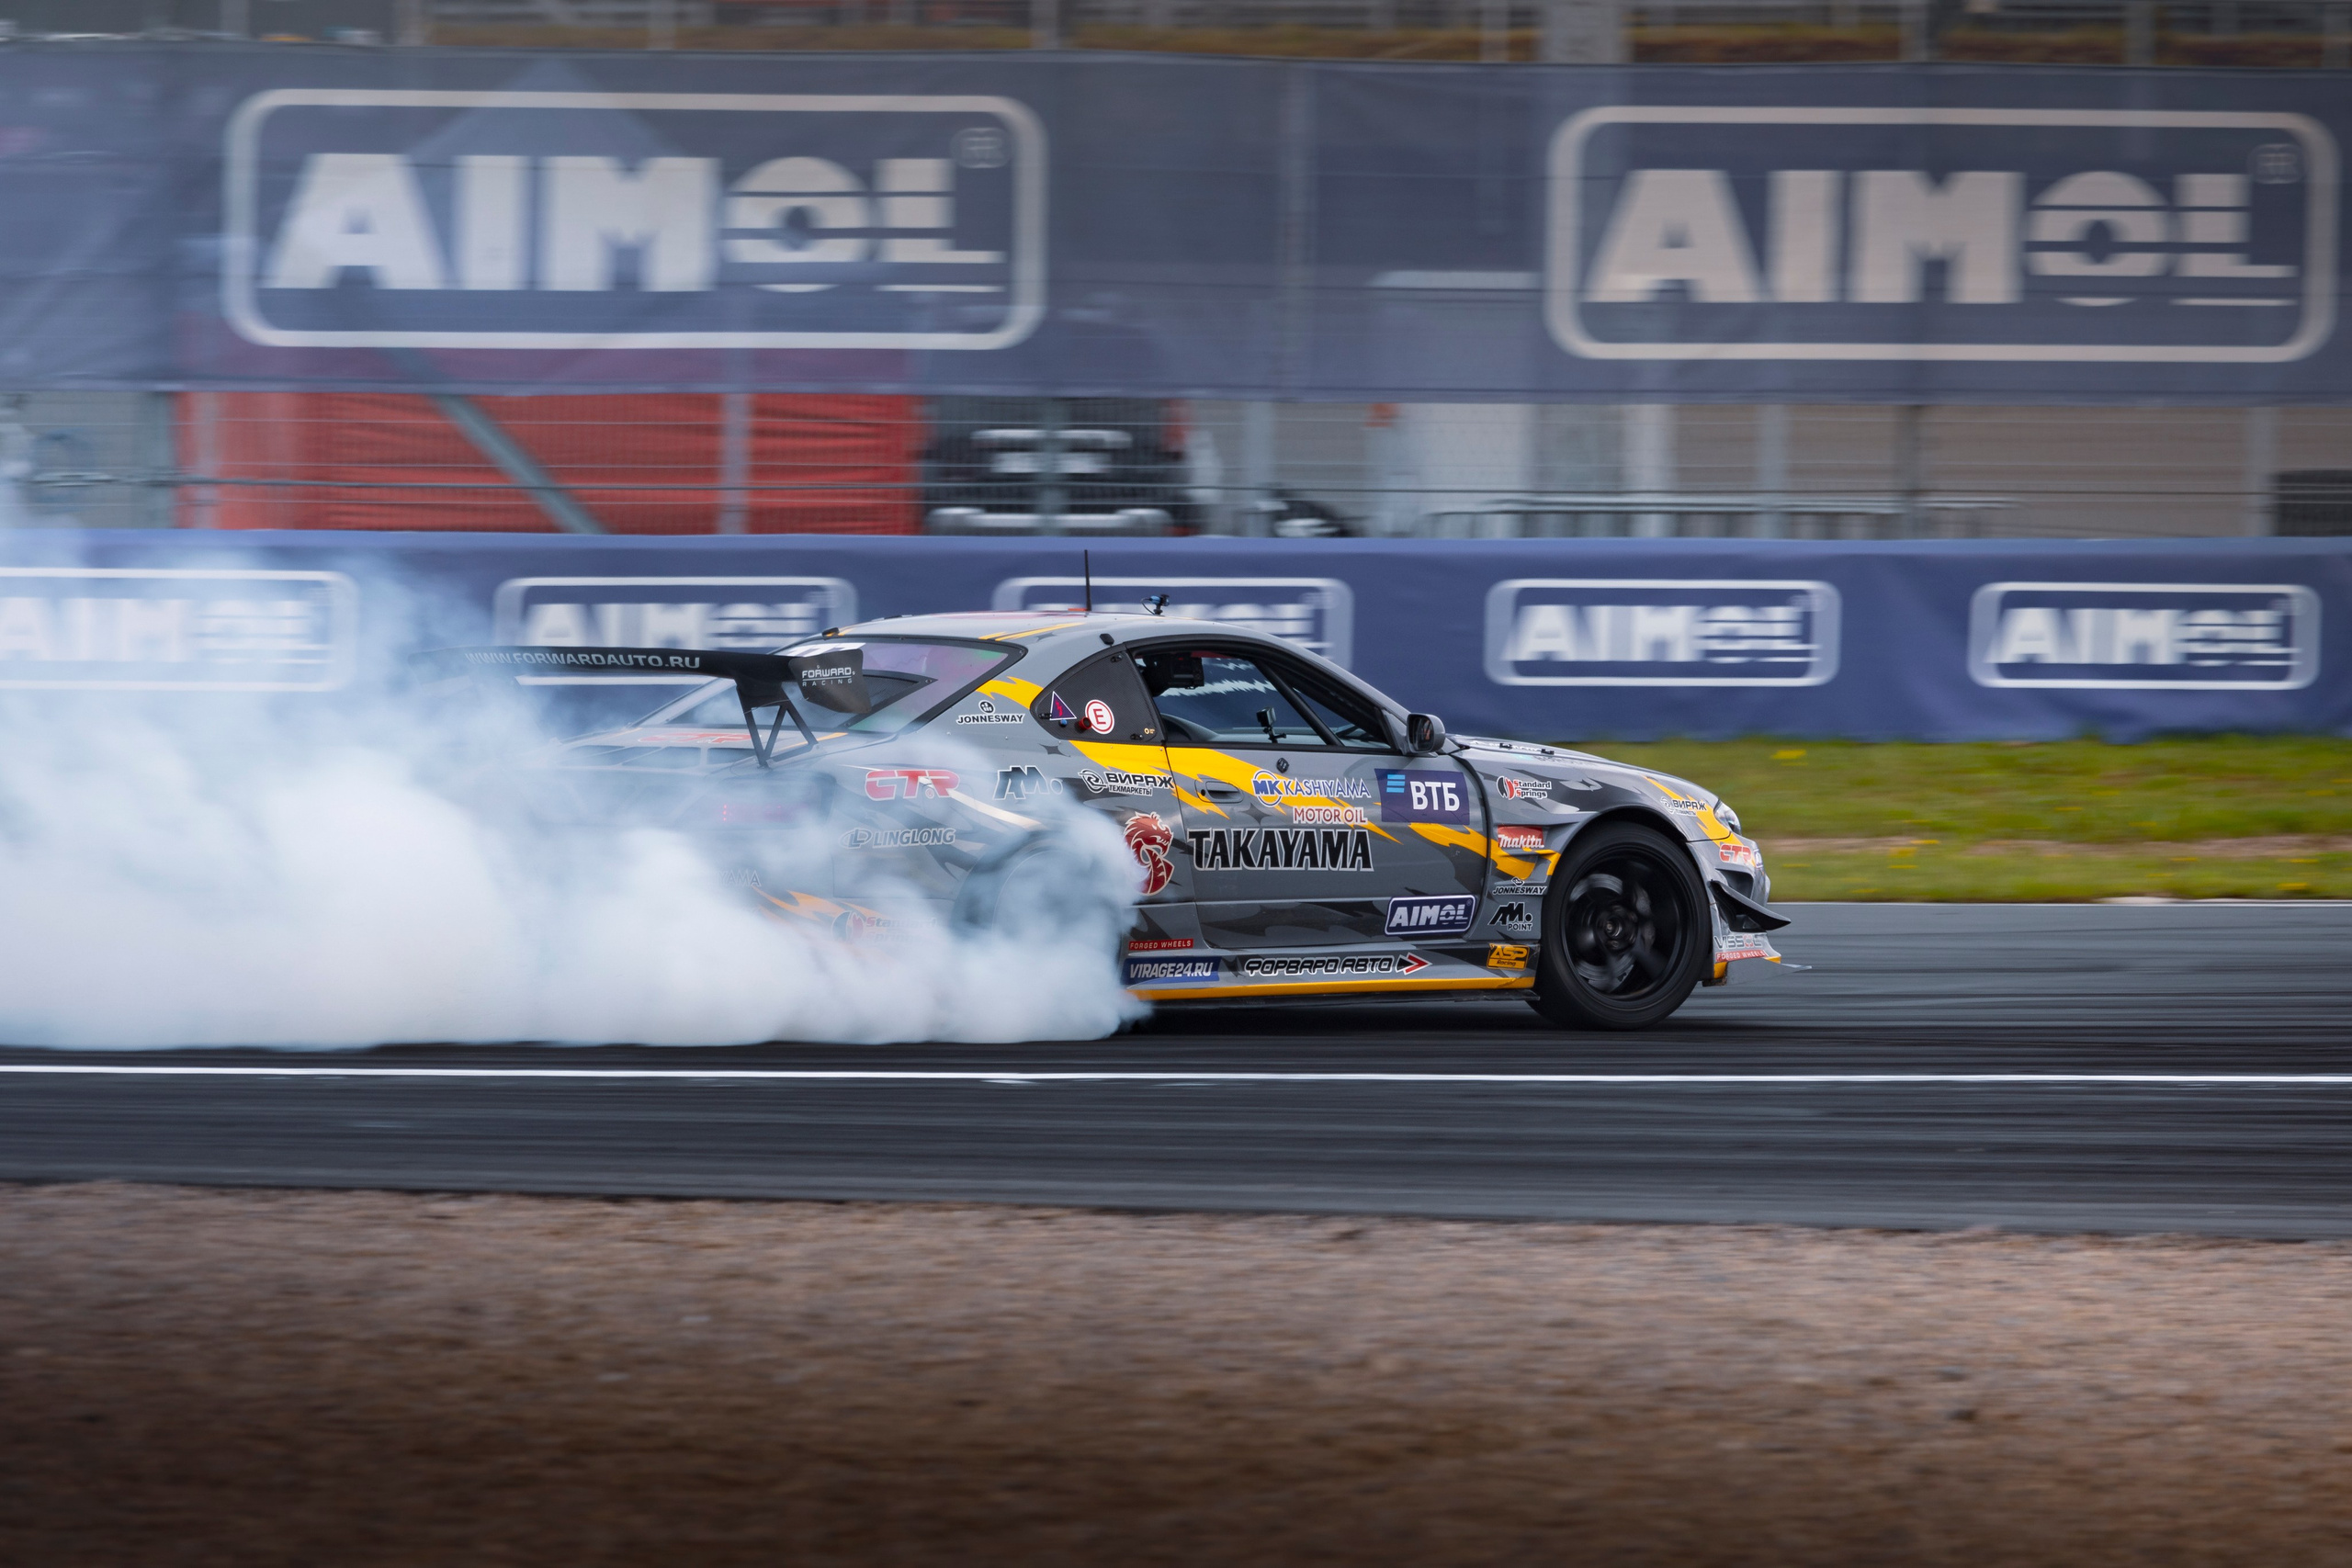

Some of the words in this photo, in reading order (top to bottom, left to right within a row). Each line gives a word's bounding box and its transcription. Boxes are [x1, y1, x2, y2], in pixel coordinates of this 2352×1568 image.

[260, 152, 1007, 293] AIMOL
[1583, 169, 2297, 306] AIMOL
[1501, 604, 1821, 663] AIMOL
[1984, 607, 2302, 666] AIMOL
[465, 652, 701, 669] WWW.FORWARDAUTO.RU
[802, 667, 852, 678] FORWARD
[802, 679, 853, 687] RACING
[957, 715, 1024, 724] JONNESWAY
[1092, 708, 1107, 725] E
[865, 770, 960, 801] CTR
[1105, 773, 1174, 789] ВИРАЖ
[1283, 778, 1371, 798] KASHIYAMA
[1513, 779, 1551, 789] Standard
[1109, 785, 1152, 795] ТЕХМАРКЕТЫ
[1410, 781, 1461, 811] ВТБ
[1516, 789, 1547, 799] Springs
[1673, 800, 1707, 810] ВИРАЖ
[1294, 807, 1341, 823] MOTOR
[1344, 808, 1366, 824] OIL
[874, 829, 956, 847] LINGLONG
[1187, 829, 1374, 871] TAKAYAMA
[1720, 844, 1752, 863] CTR
[1493, 886, 1547, 895] JONNESWAY
[1389, 905, 1468, 927] AIMOL
[1508, 923, 1532, 931] POINT
[1490, 946, 1528, 960] ASP
[1716, 953, 1741, 961] FORGED
[1742, 950, 1766, 958] WHEELS
[1129, 962, 1213, 979] VIRAGE24.RU
[1245, 957, 1338, 976] ФОРВАРД
[1340, 955, 1394, 974] АВТО
